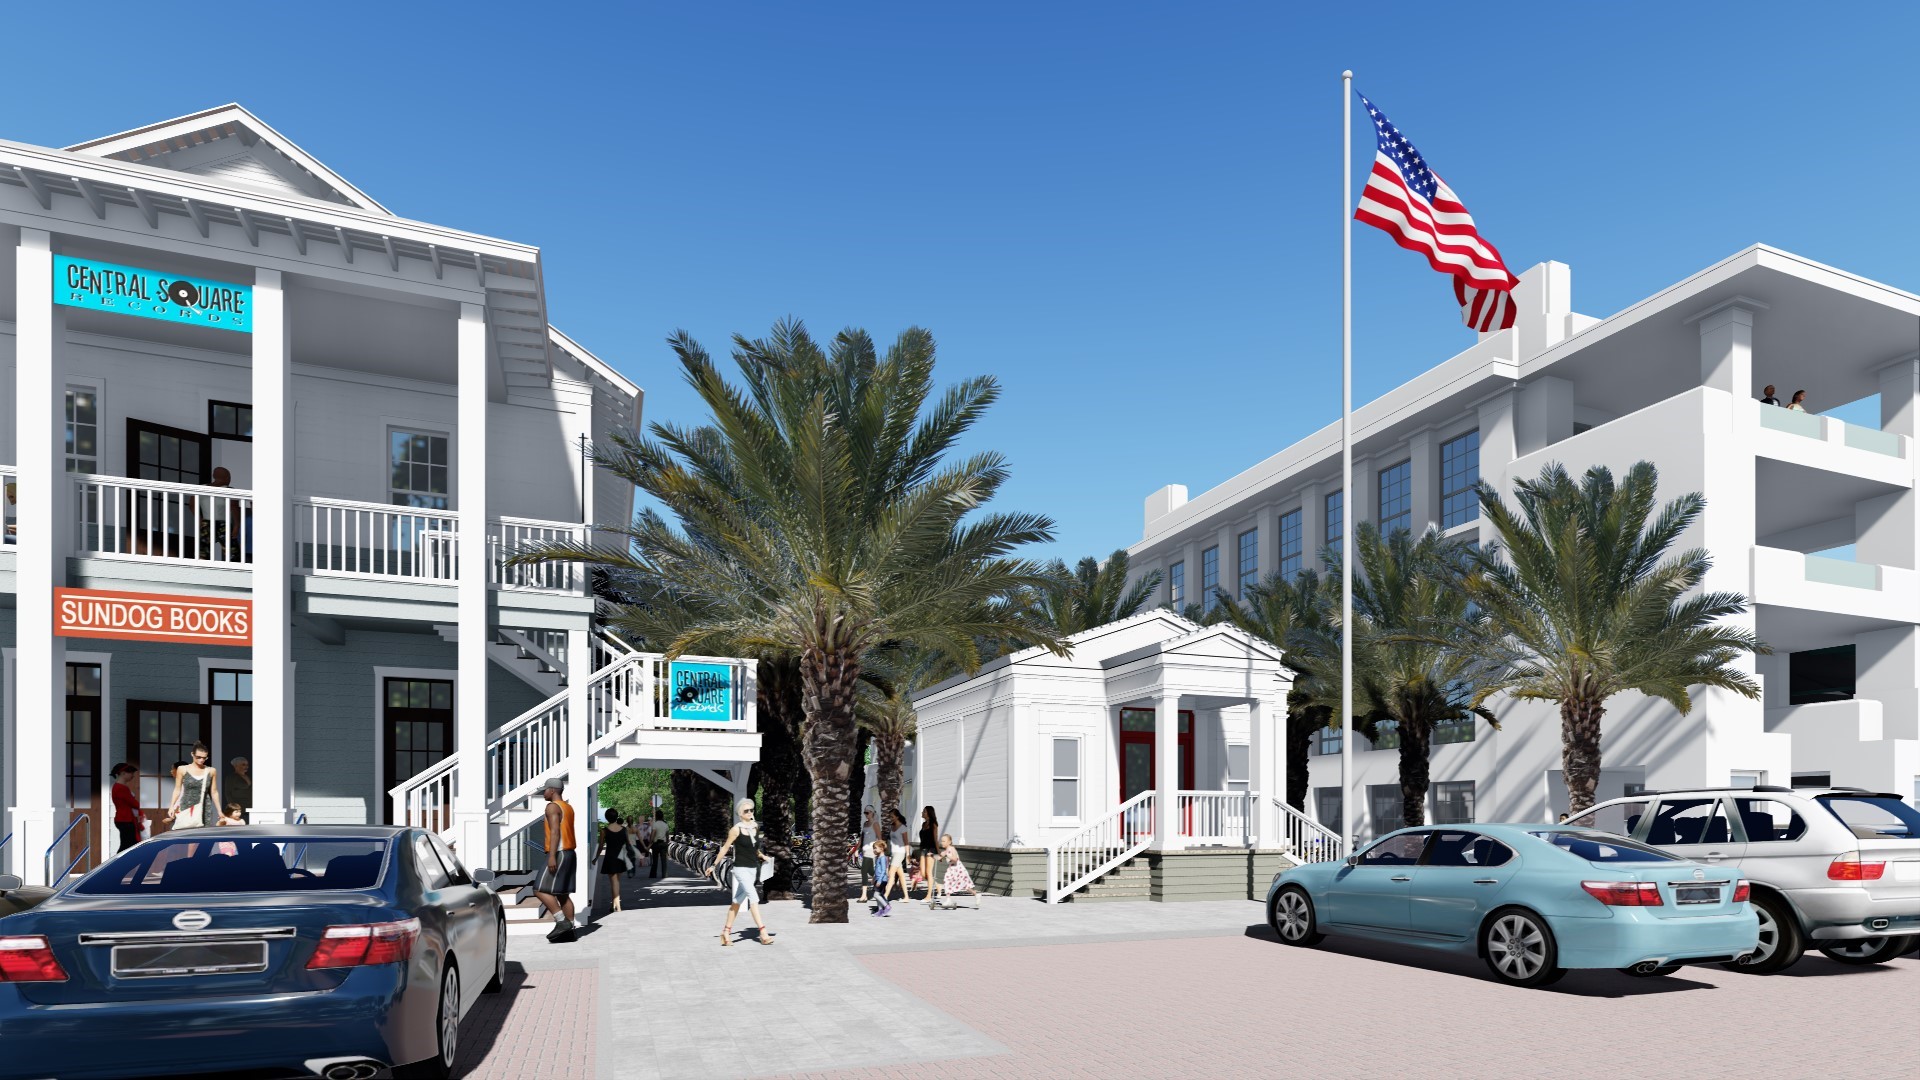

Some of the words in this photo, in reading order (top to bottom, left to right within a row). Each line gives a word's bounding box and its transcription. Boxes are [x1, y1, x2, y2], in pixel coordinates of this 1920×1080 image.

[67, 264, 151, 301] CENTRAL
[157, 278, 244, 314] SQUARE
[70, 292, 244, 325] RECORDS
[61, 600, 163, 629] SUNDOG
[170, 607, 248, 634] BOOKS
[676, 670, 726, 689] CENTRAL
[676, 686, 724, 705] SQUARE
